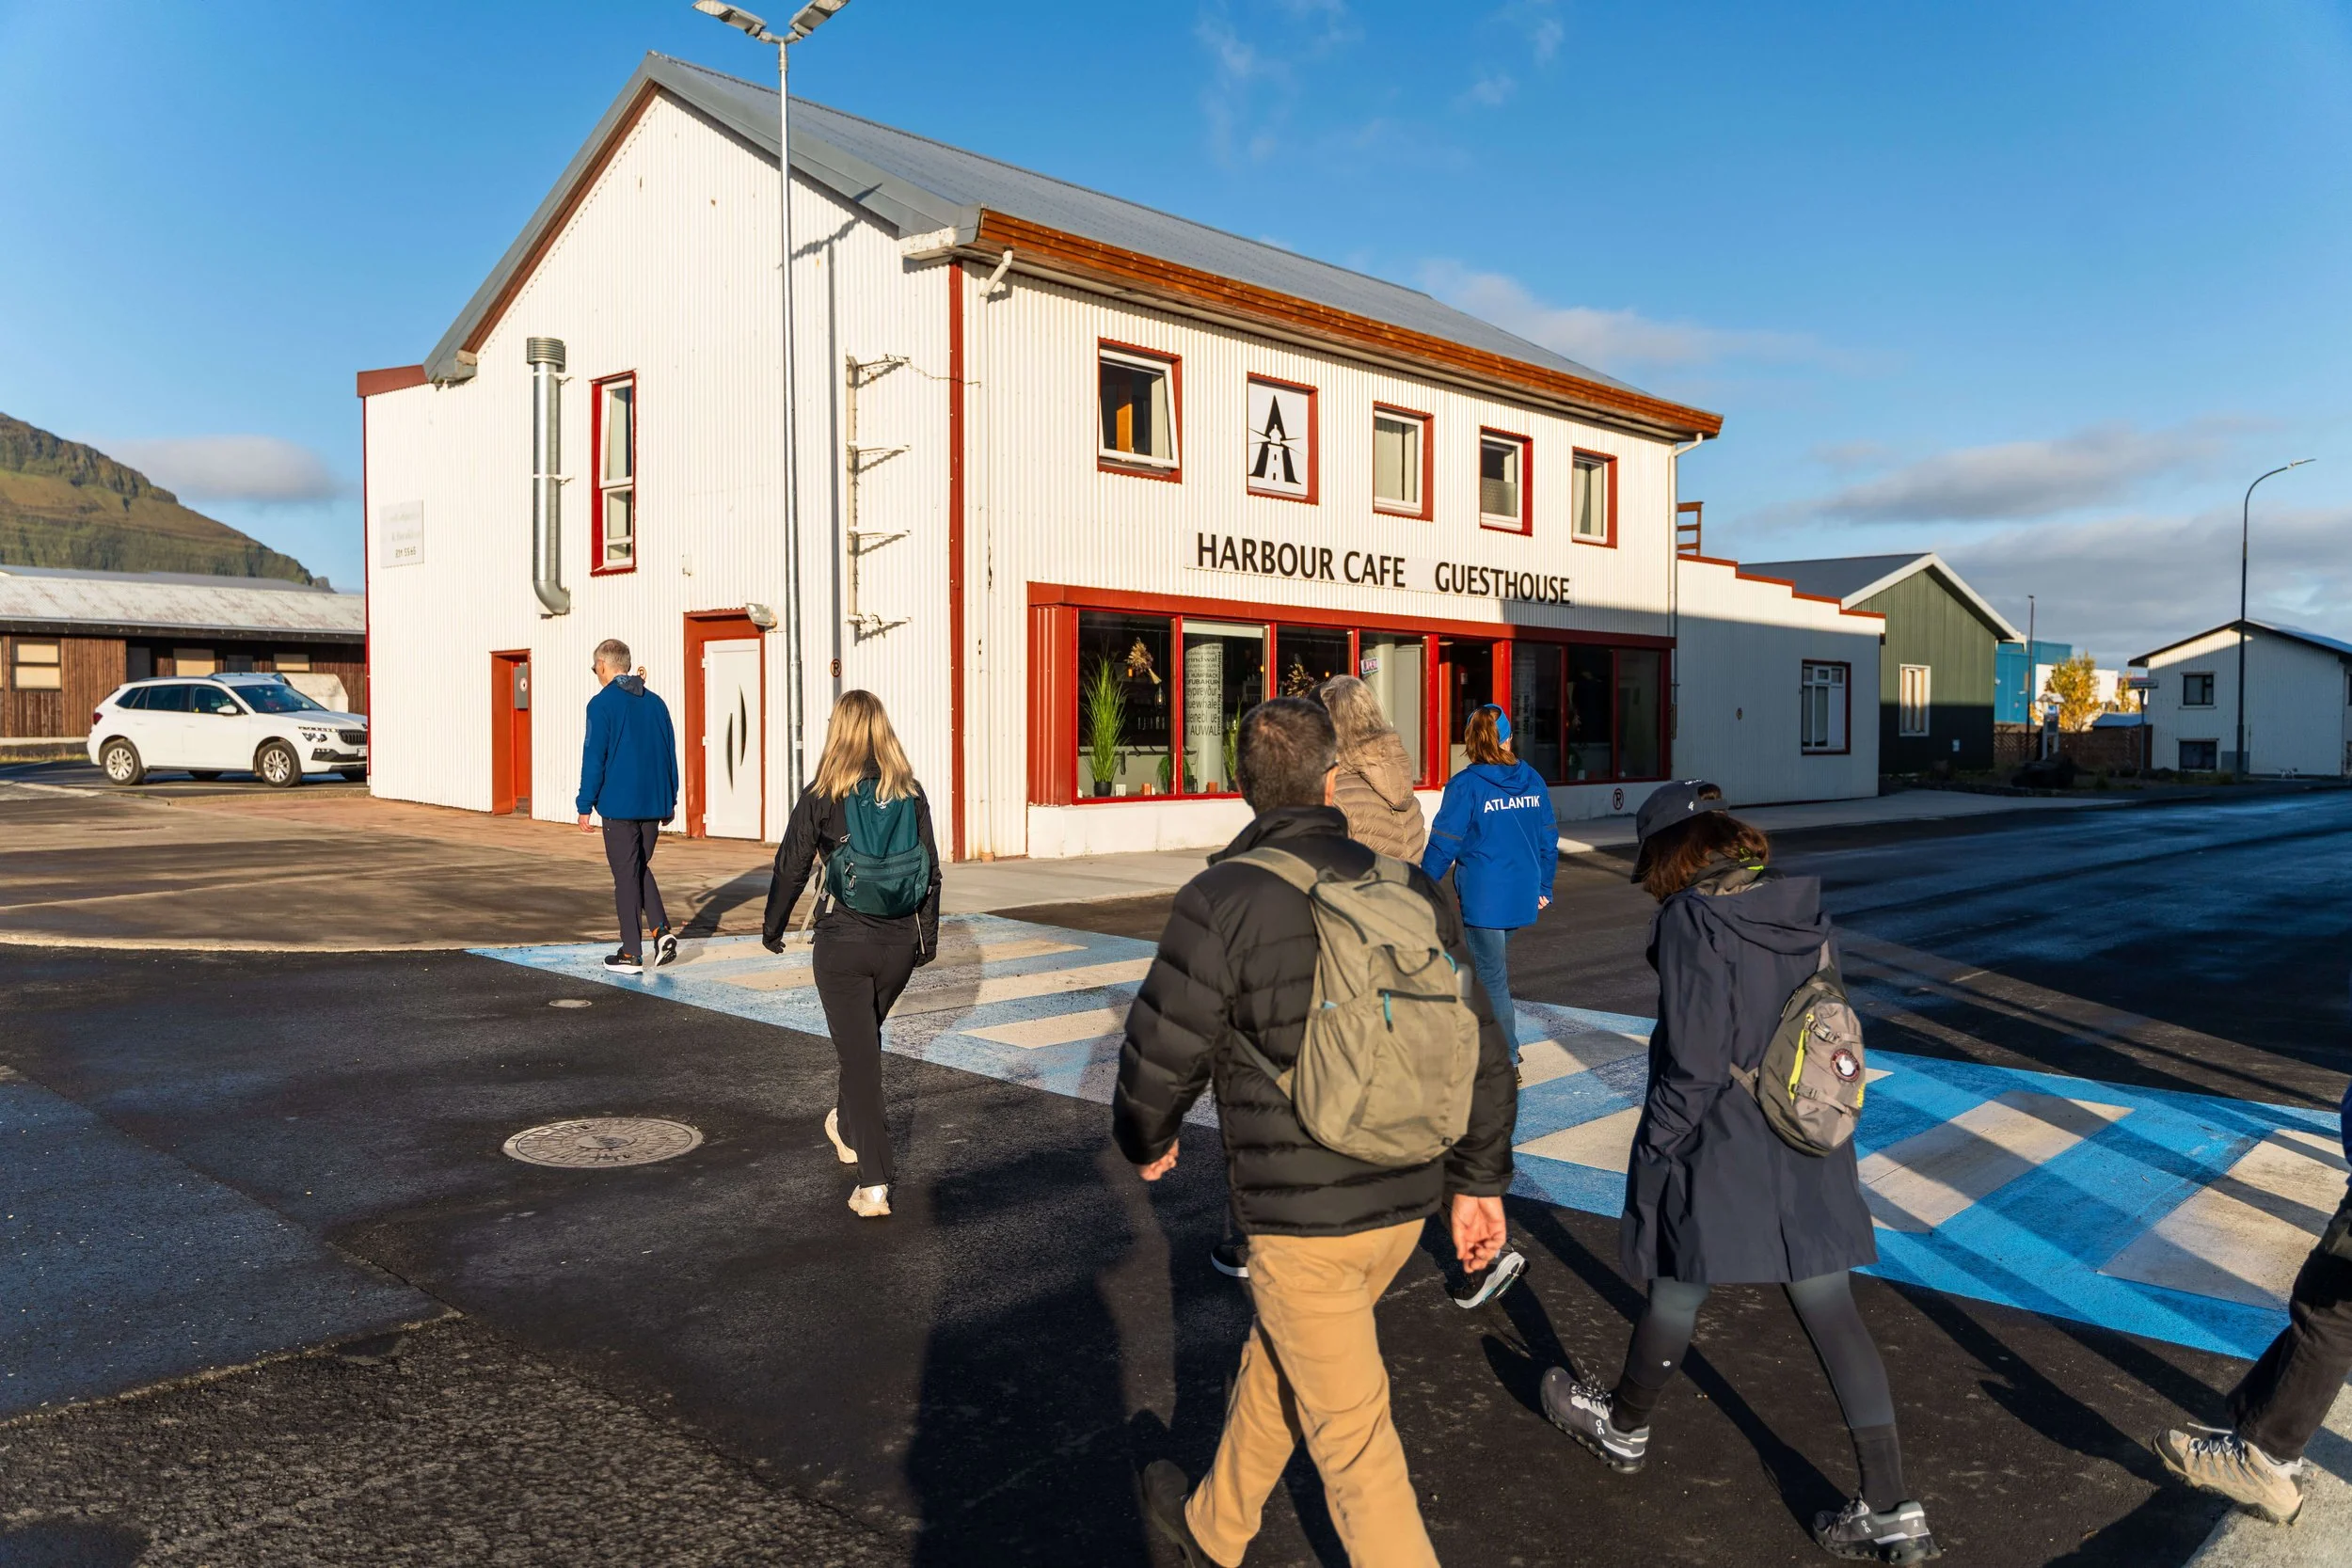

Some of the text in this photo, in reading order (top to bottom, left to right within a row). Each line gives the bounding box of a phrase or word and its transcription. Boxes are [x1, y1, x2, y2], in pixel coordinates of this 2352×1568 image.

[1197, 532, 1570, 605] HARBOUR CAFE GUESTHOUSE
[1484, 795, 1540, 814] ATLANTIK
